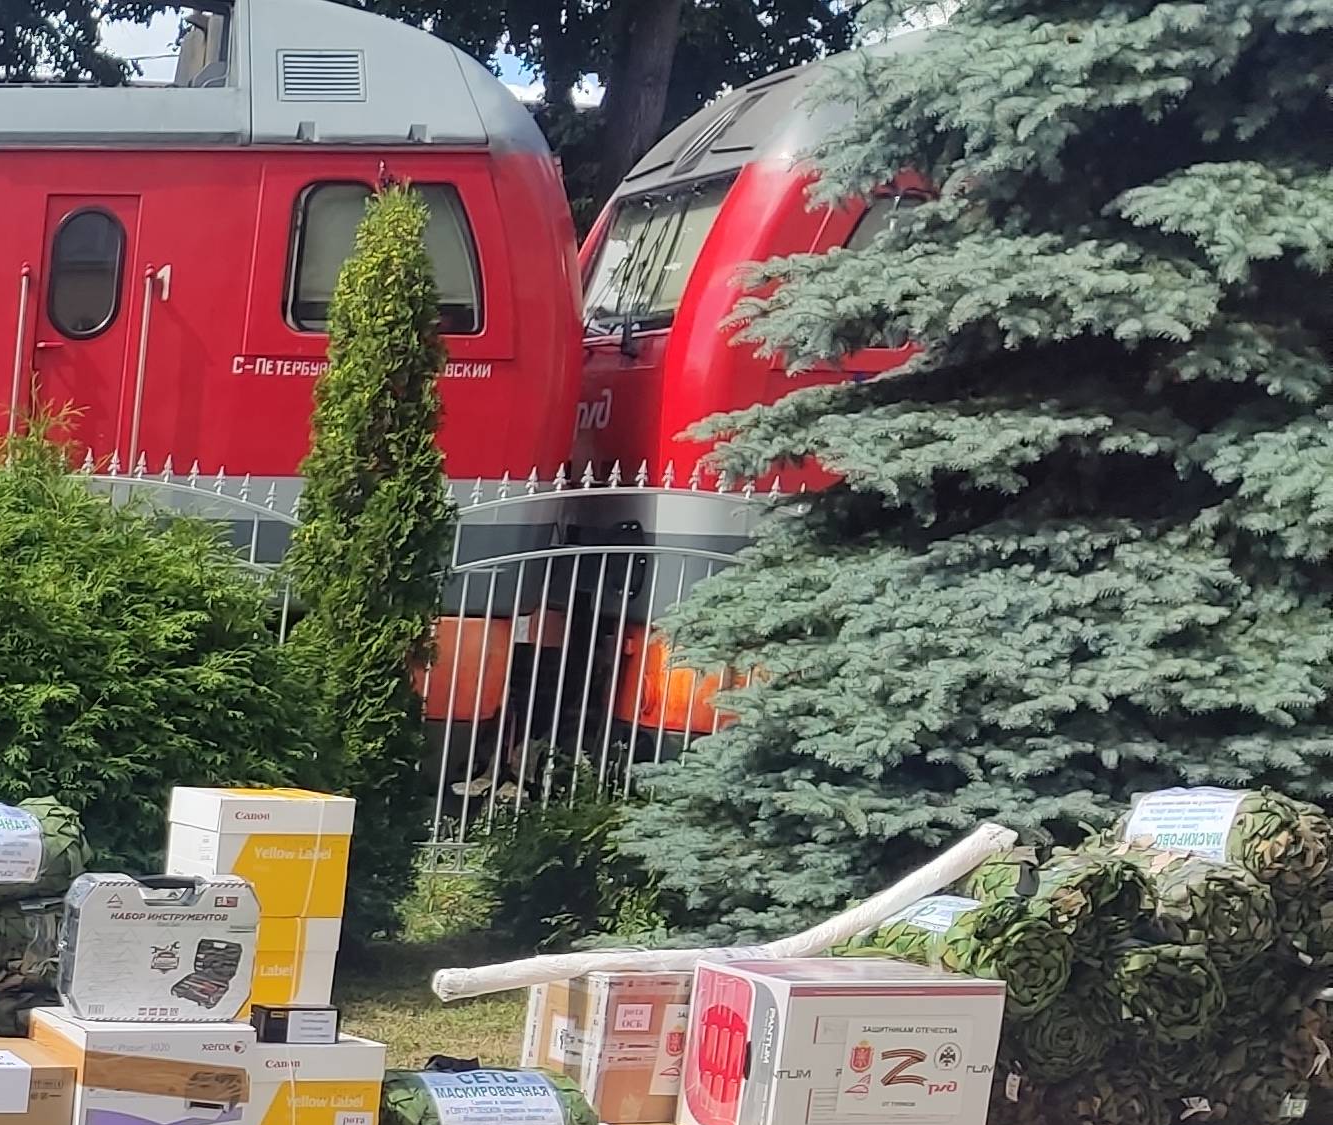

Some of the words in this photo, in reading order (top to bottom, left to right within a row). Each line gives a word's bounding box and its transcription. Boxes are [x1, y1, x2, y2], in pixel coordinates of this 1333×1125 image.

[156, 264, 171, 301] 1
[232, 356, 333, 376] С-ПЕТЕРБУР
[234, 810, 271, 821] Canon
[1155, 832, 1223, 849] МАСКИРОВО
[254, 846, 296, 859] Yellow
[298, 846, 332, 860] Label
[110, 912, 146, 921] НАБОР
[147, 913, 229, 922] ИНСТРУМЕНТОВ
[259, 964, 294, 977] Label
[621, 1019, 643, 1029] ОСБ
[861, 1026, 914, 1034] ЗАЩИТНИКАМ
[915, 1026, 958, 1035] ОТЕЧЕСТВА
[761, 1007, 776, 1064] PANTUM
[201, 1043, 231, 1052] xerox
[264, 1058, 301, 1069] Canon
[880, 1048, 928, 1087] Z
[456, 1071, 519, 1085] СЕТЬ
[435, 1086, 551, 1099] МАСКИРОВОЧНАЯ
[287, 1095, 329, 1108] Yellow
[330, 1094, 365, 1108] Label
